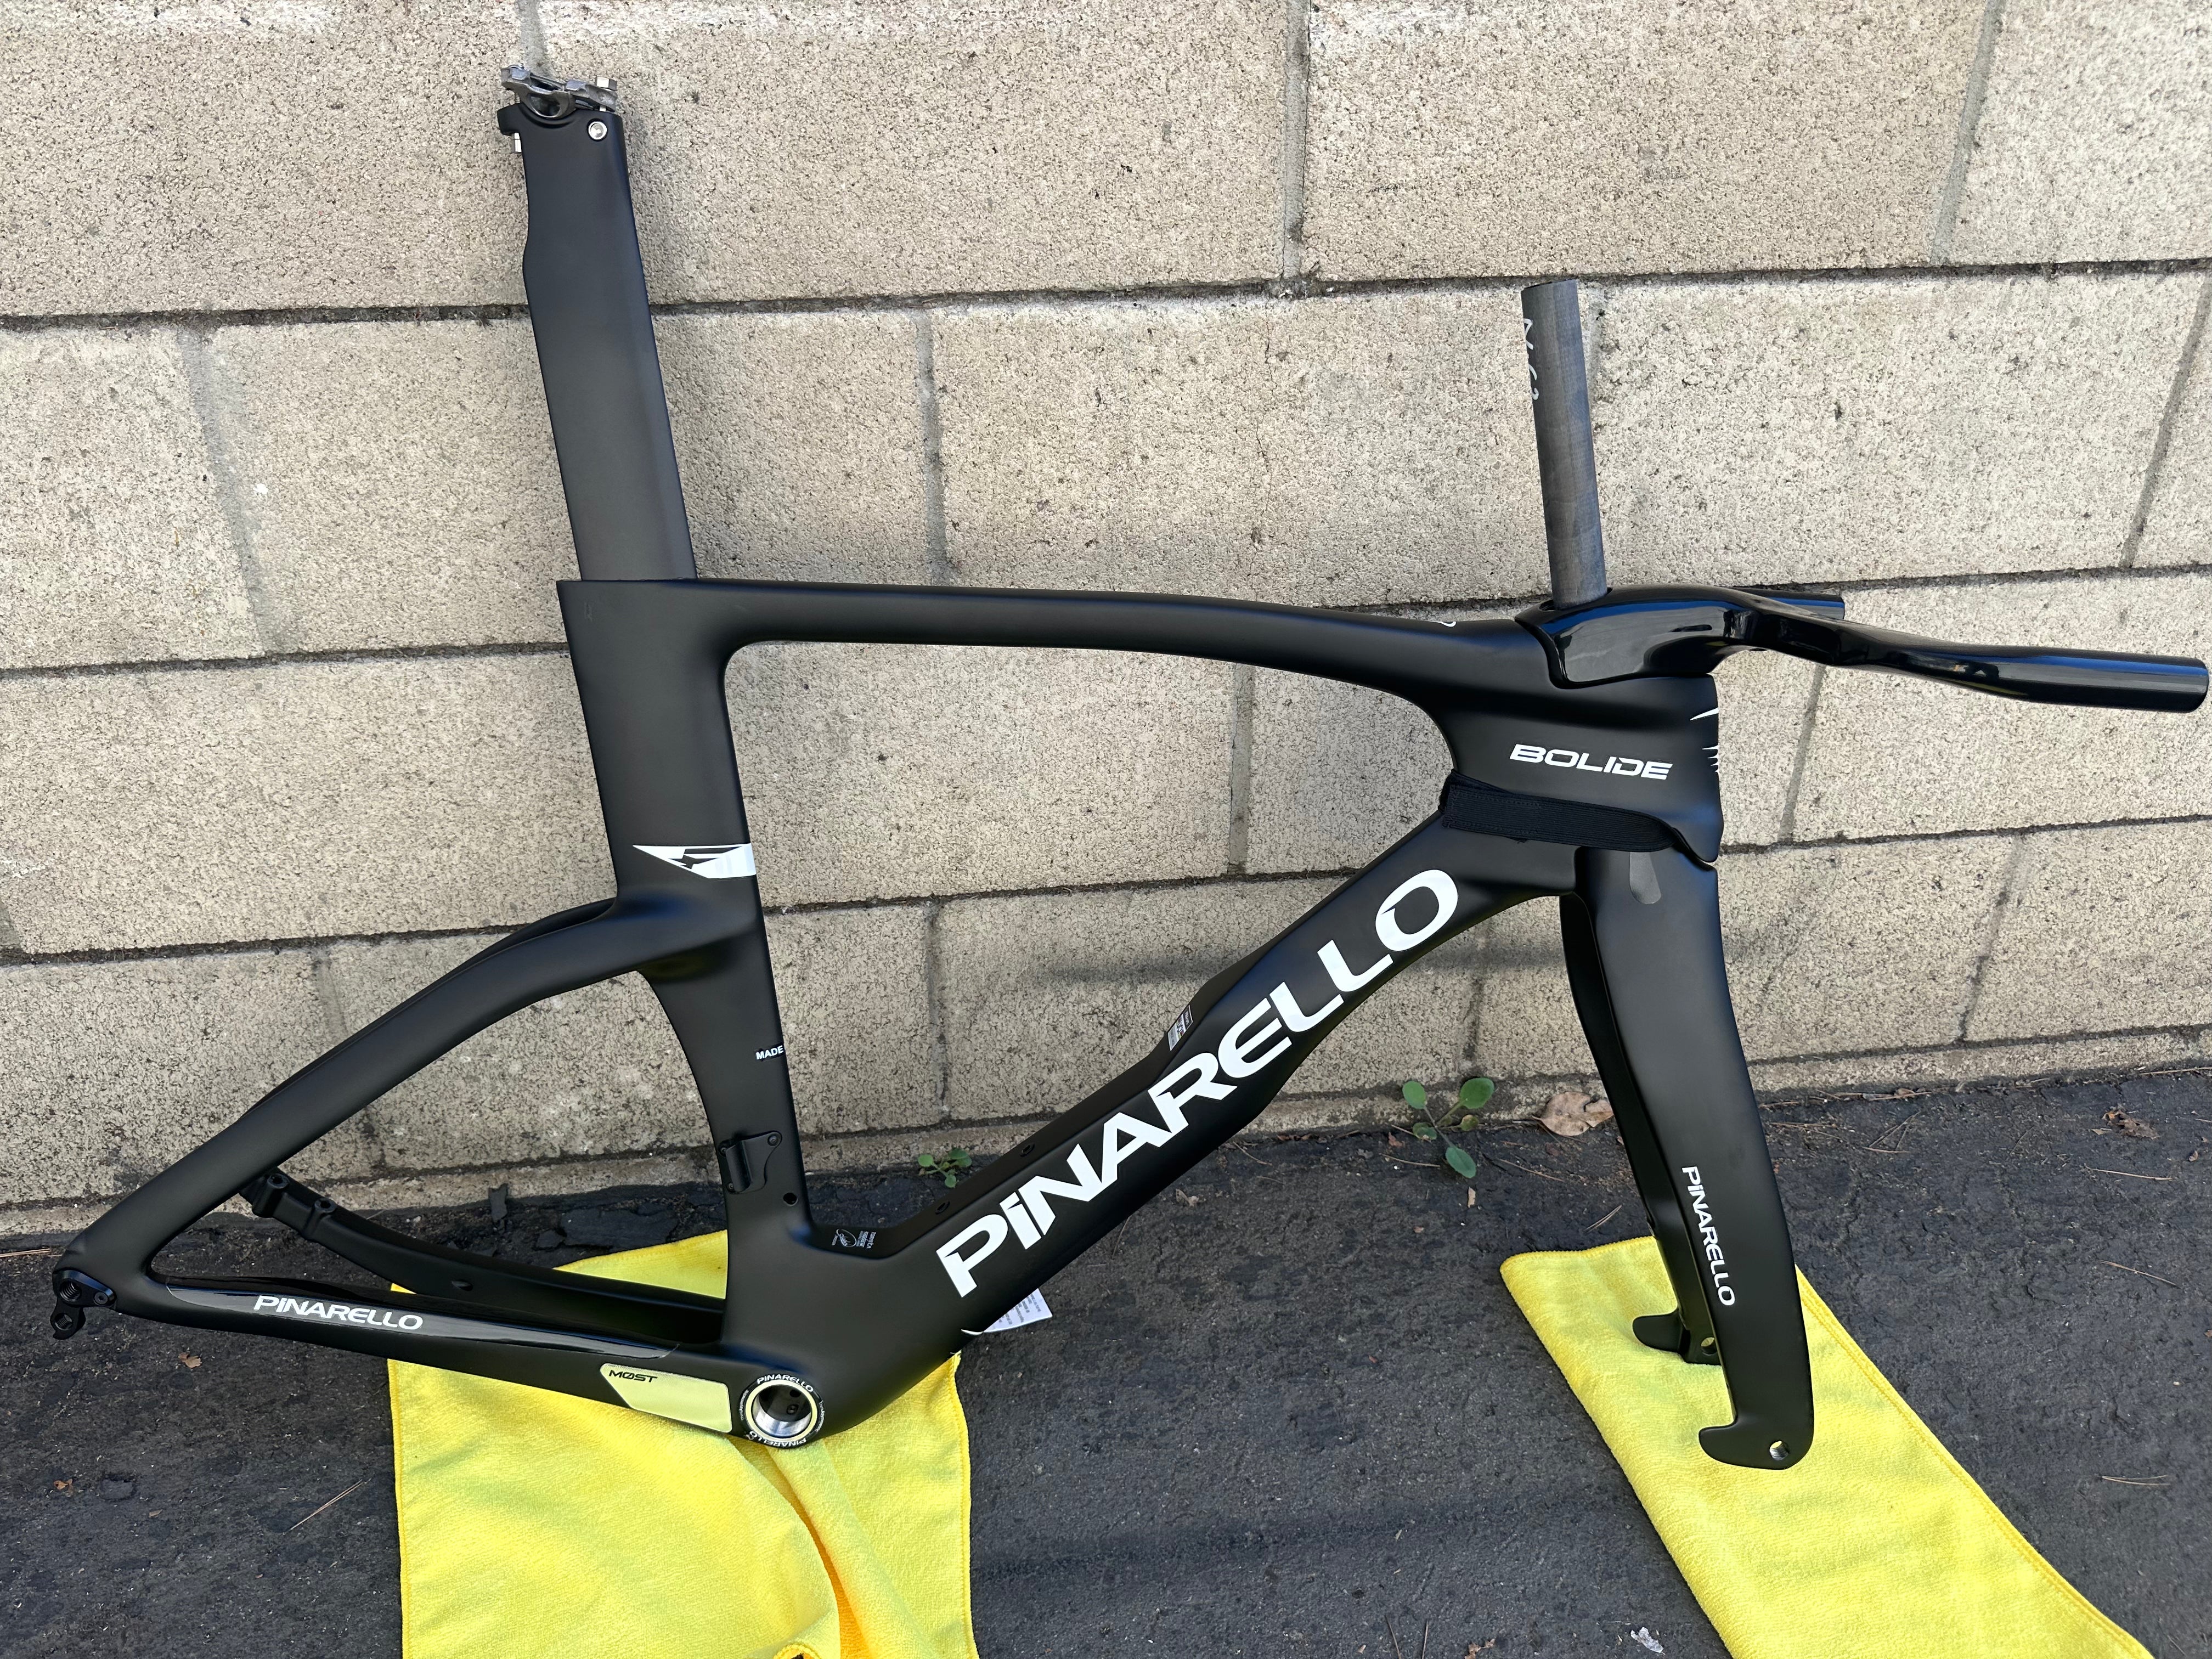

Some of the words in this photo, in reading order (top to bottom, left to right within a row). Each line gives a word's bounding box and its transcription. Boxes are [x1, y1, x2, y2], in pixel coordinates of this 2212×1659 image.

[1510, 744, 1673, 780] BOLIDE
[756, 1045, 783, 1060] MADE
[936, 870, 1458, 1297] PINARELLO
[1681, 1166, 1735, 1306] PINARELLO
[253, 1295, 423, 1330] PINARELLO
[757, 1374, 814, 1392] PINARELLO
[749, 1430, 806, 1447] PINARELLO
